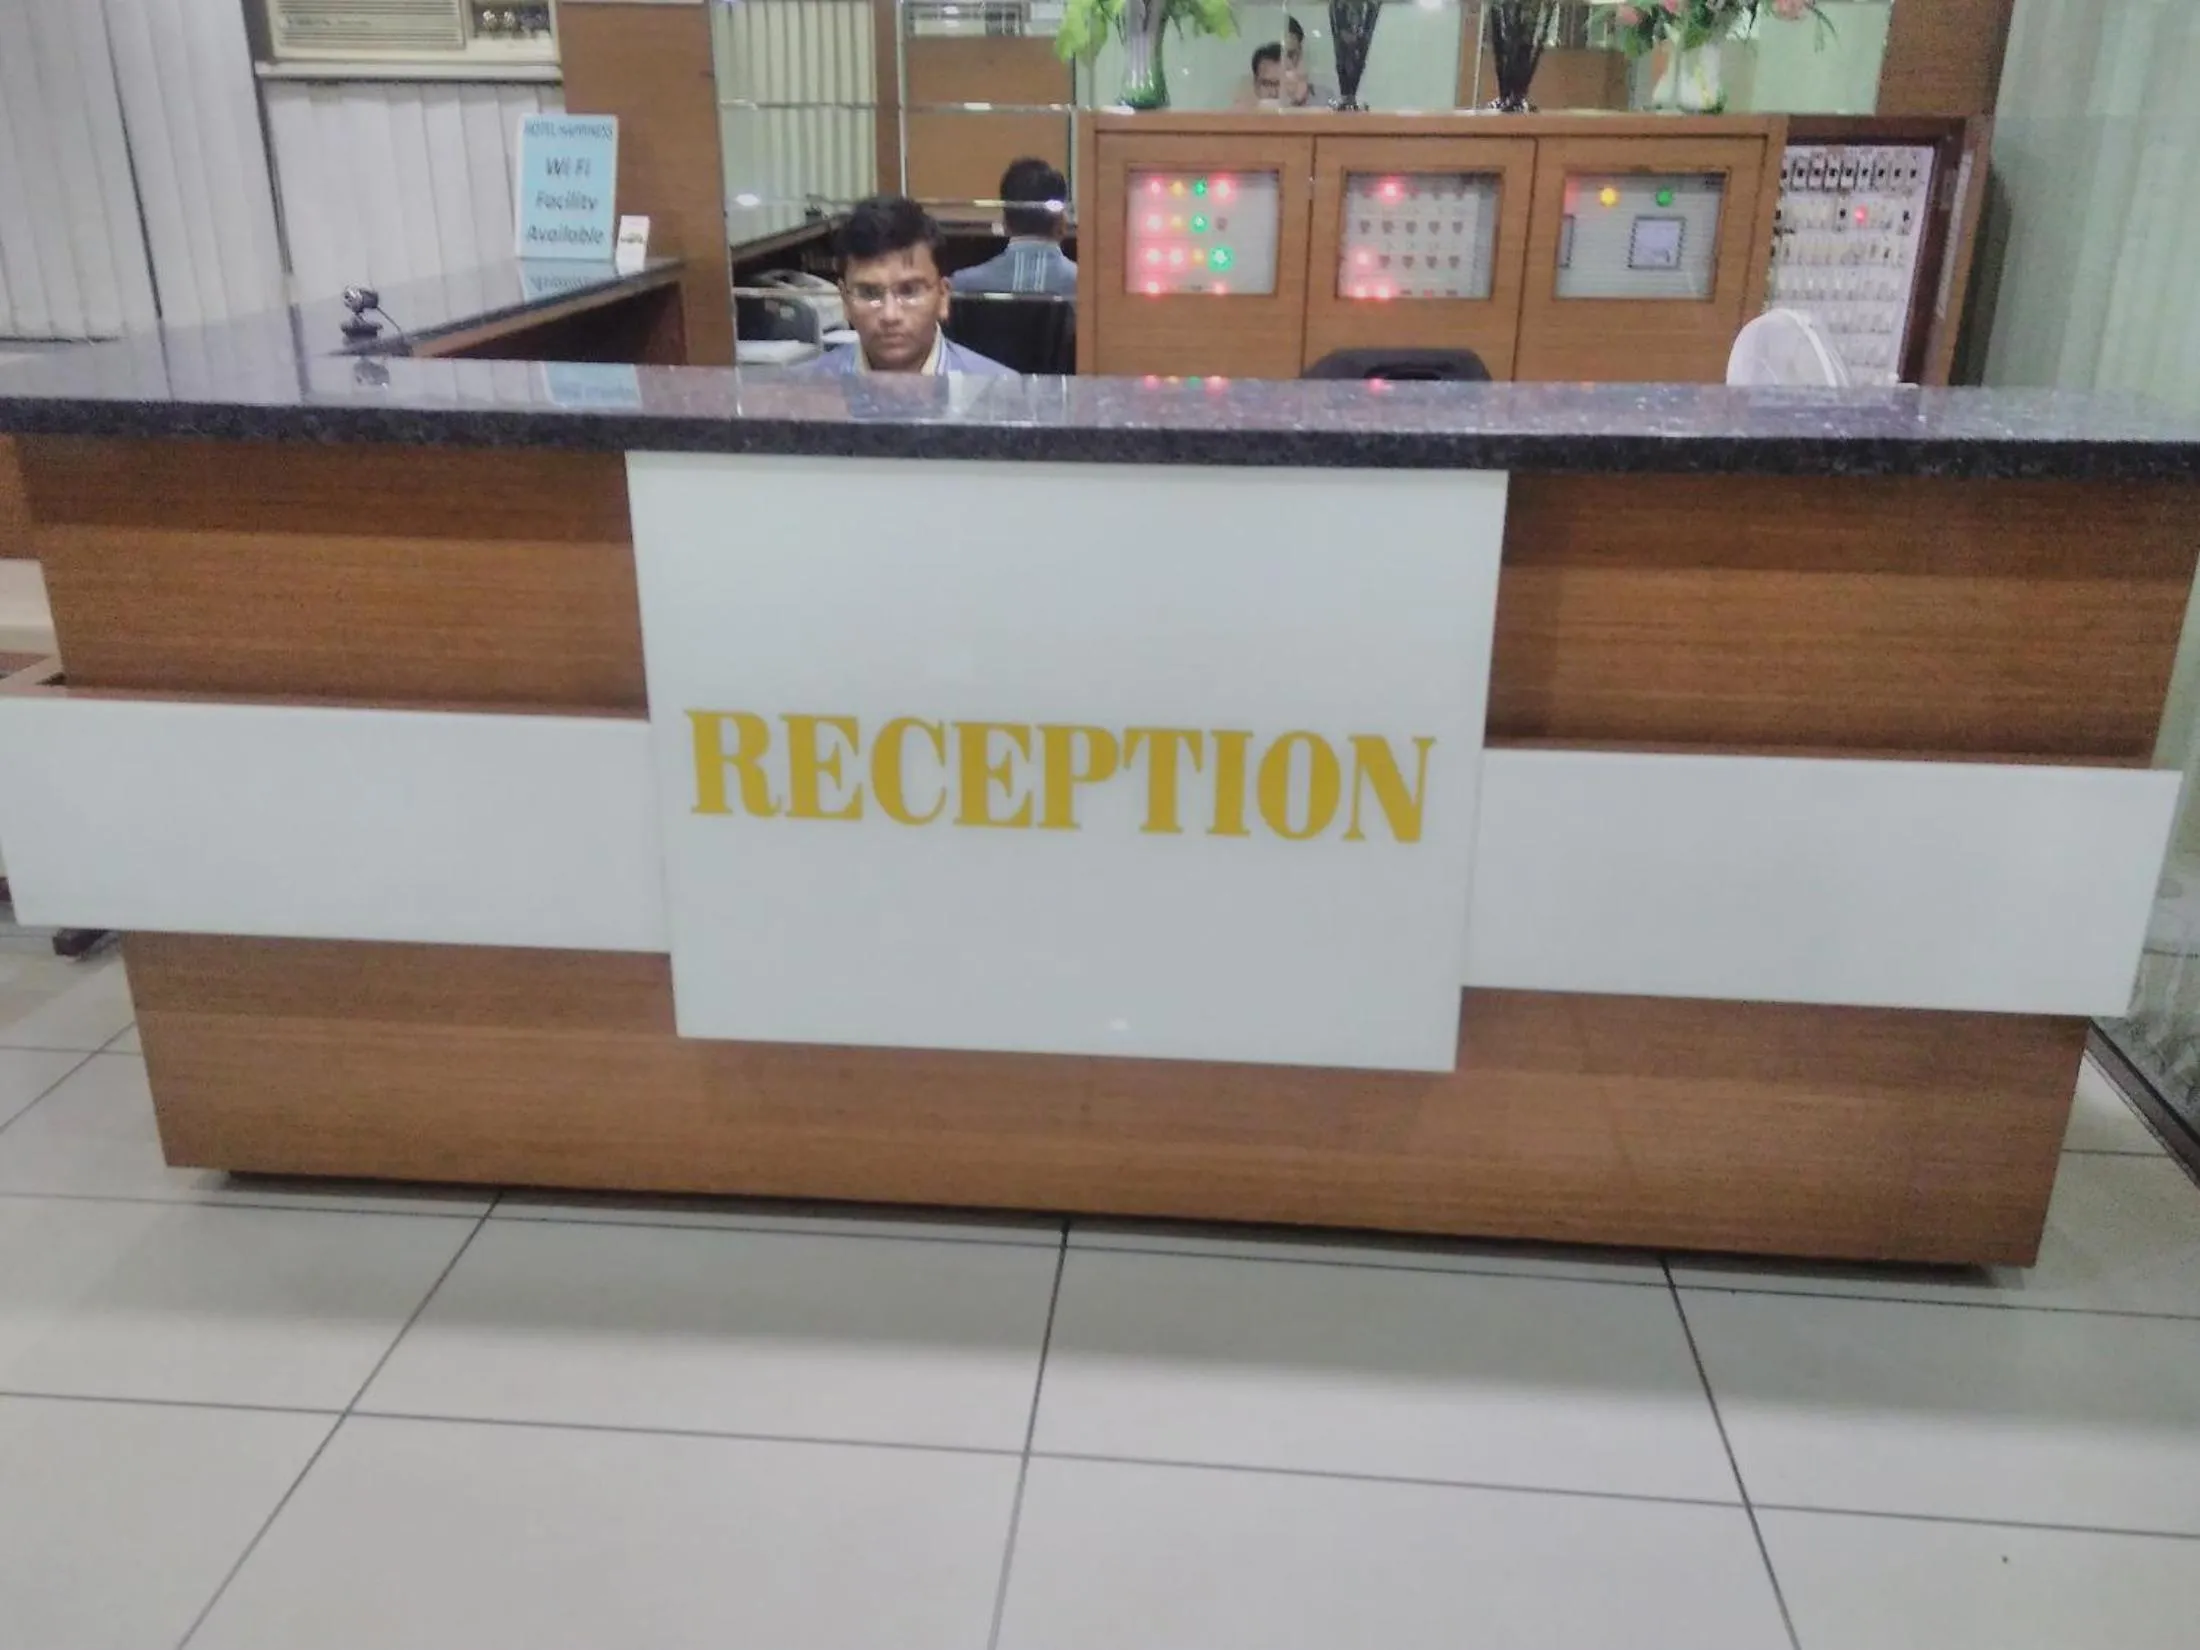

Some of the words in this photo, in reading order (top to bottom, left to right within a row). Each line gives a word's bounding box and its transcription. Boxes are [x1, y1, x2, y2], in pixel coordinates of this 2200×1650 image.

[536, 190, 599, 210] Facility
[527, 223, 604, 244] Available
[684, 709, 1436, 843] RECEPTION
